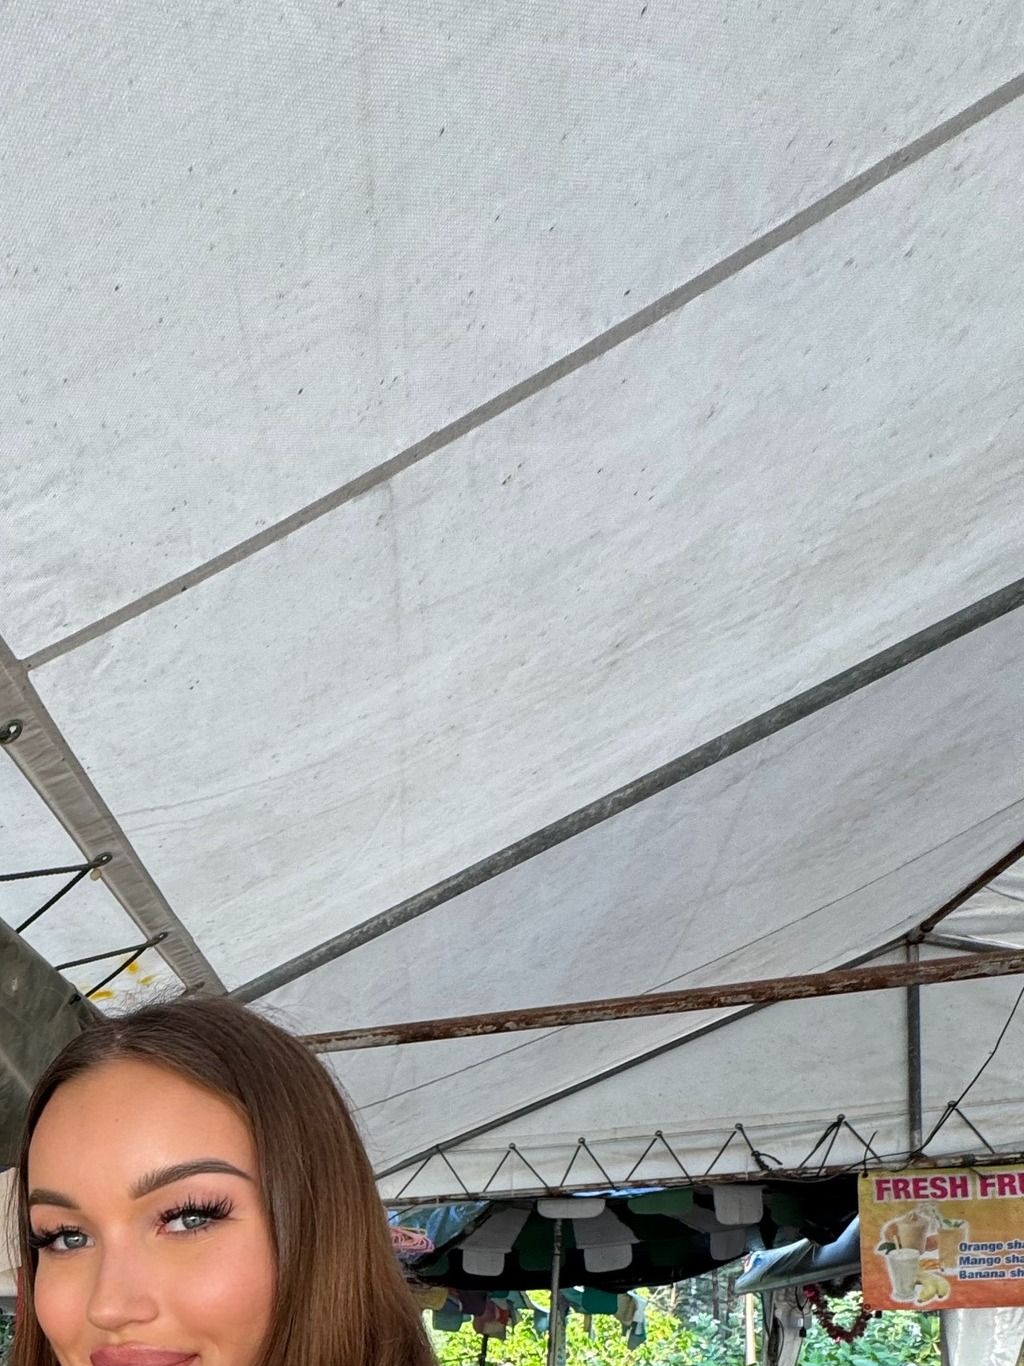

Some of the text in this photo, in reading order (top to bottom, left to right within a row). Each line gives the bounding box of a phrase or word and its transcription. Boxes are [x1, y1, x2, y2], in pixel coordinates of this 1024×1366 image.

[875, 1175, 970, 1201] FRESH
[959, 1242, 1004, 1252] Orange
[959, 1256, 1002, 1267] Mango
[959, 1269, 1005, 1279] Banana
